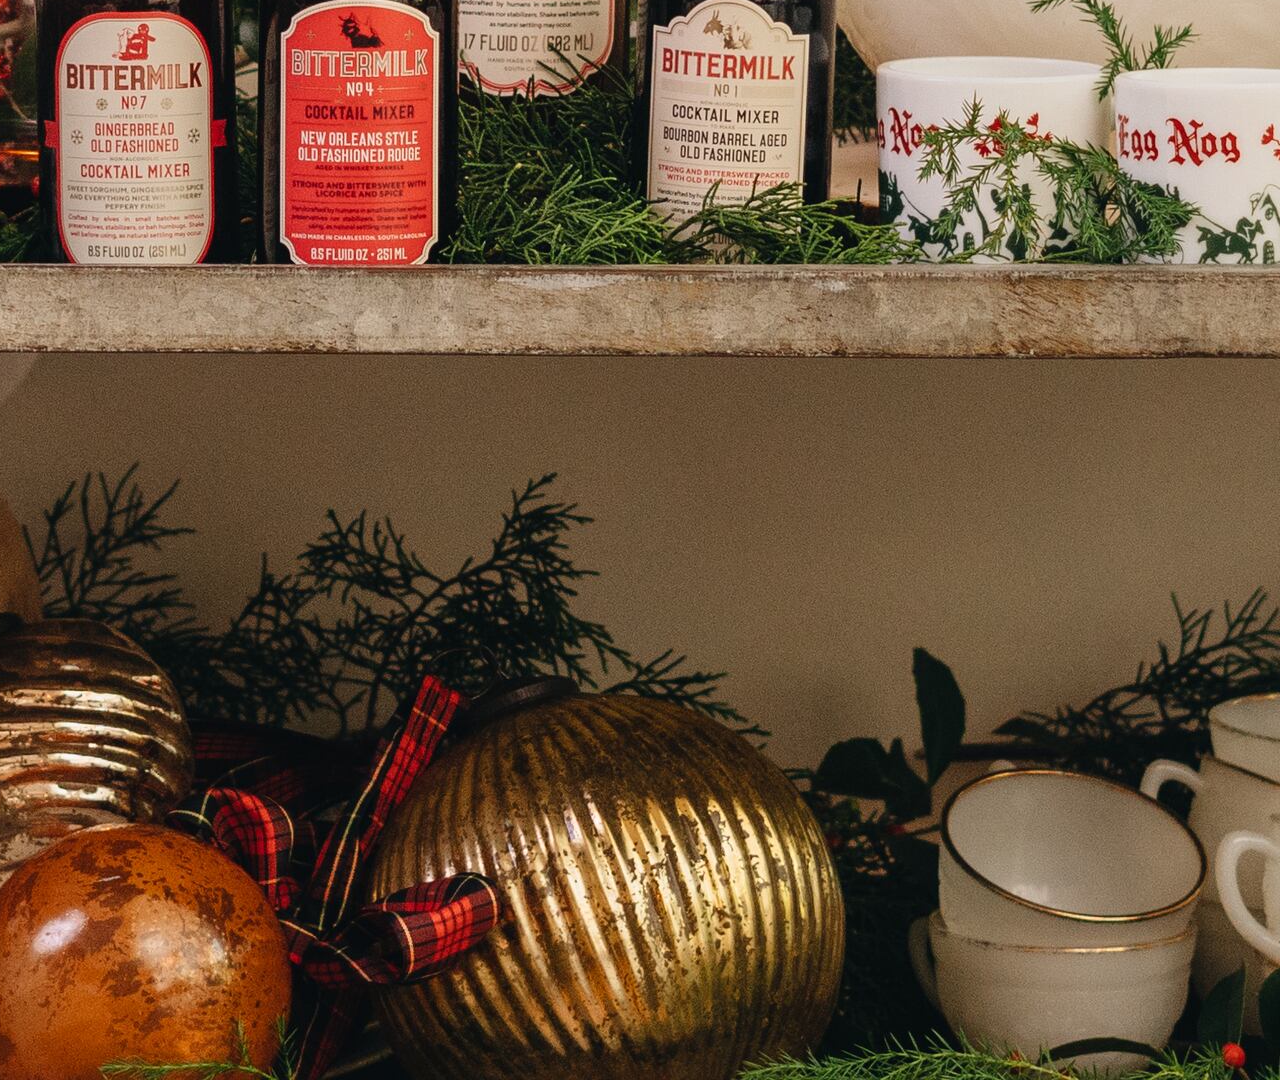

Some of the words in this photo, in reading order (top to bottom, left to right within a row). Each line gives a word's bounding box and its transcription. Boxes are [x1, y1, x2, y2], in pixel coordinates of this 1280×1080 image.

[464, 33, 476, 50] 17
[480, 34, 518, 51] FLUID
[521, 35, 538, 52] OZ
[574, 32, 594, 52] ML)
[292, 49, 428, 78] BITTERMILK
[662, 48, 795, 80] BITTERMILK
[67, 63, 202, 90] BITTERMILK
[366, 82, 374, 96] 4
[141, 96, 146, 109] 7
[305, 105, 368, 120] COCKTAIL
[373, 105, 414, 119] MIXER
[672, 104, 731, 122] COCKTAIL
[737, 110, 779, 124] MIXER
[95, 122, 174, 136] GINGERBREAD
[664, 126, 708, 144] BOURBON
[712, 132, 756, 146] BARREL
[760, 134, 787, 146] AGED
[888, 107, 942, 157] No
[91, 140, 111, 153] OLD
[116, 139, 178, 153] FASHIONED
[301, 131, 325, 145] NEW
[329, 132, 382, 146] ORLEANS
[386, 131, 418, 145] STYLE
[1166, 118, 1240, 167] Nog
[298, 147, 318, 162] OLD
[321, 148, 384, 162] FASHIONED
[388, 147, 420, 161] ROUGE
[681, 145, 700, 159] OLD
[704, 148, 766, 162] FASHIONED
[81, 164, 143, 178] COCKTAIL
[148, 163, 190, 177] MIXER
[658, 164, 684, 173] STRONG
[399, 232, 427, 240] CAROLINA
[88, 246, 101, 257] 8.5
[103, 246, 132, 258] FLUID
[134, 246, 144, 258] OZ
[149, 244, 168, 258] (251
[170, 244, 186, 257] ML)
[311, 248, 324, 260] 8.5
[326, 248, 354, 260] FLUID
[356, 248, 368, 260] OZ
[377, 248, 392, 260] 251
[395, 248, 407, 260] ML
